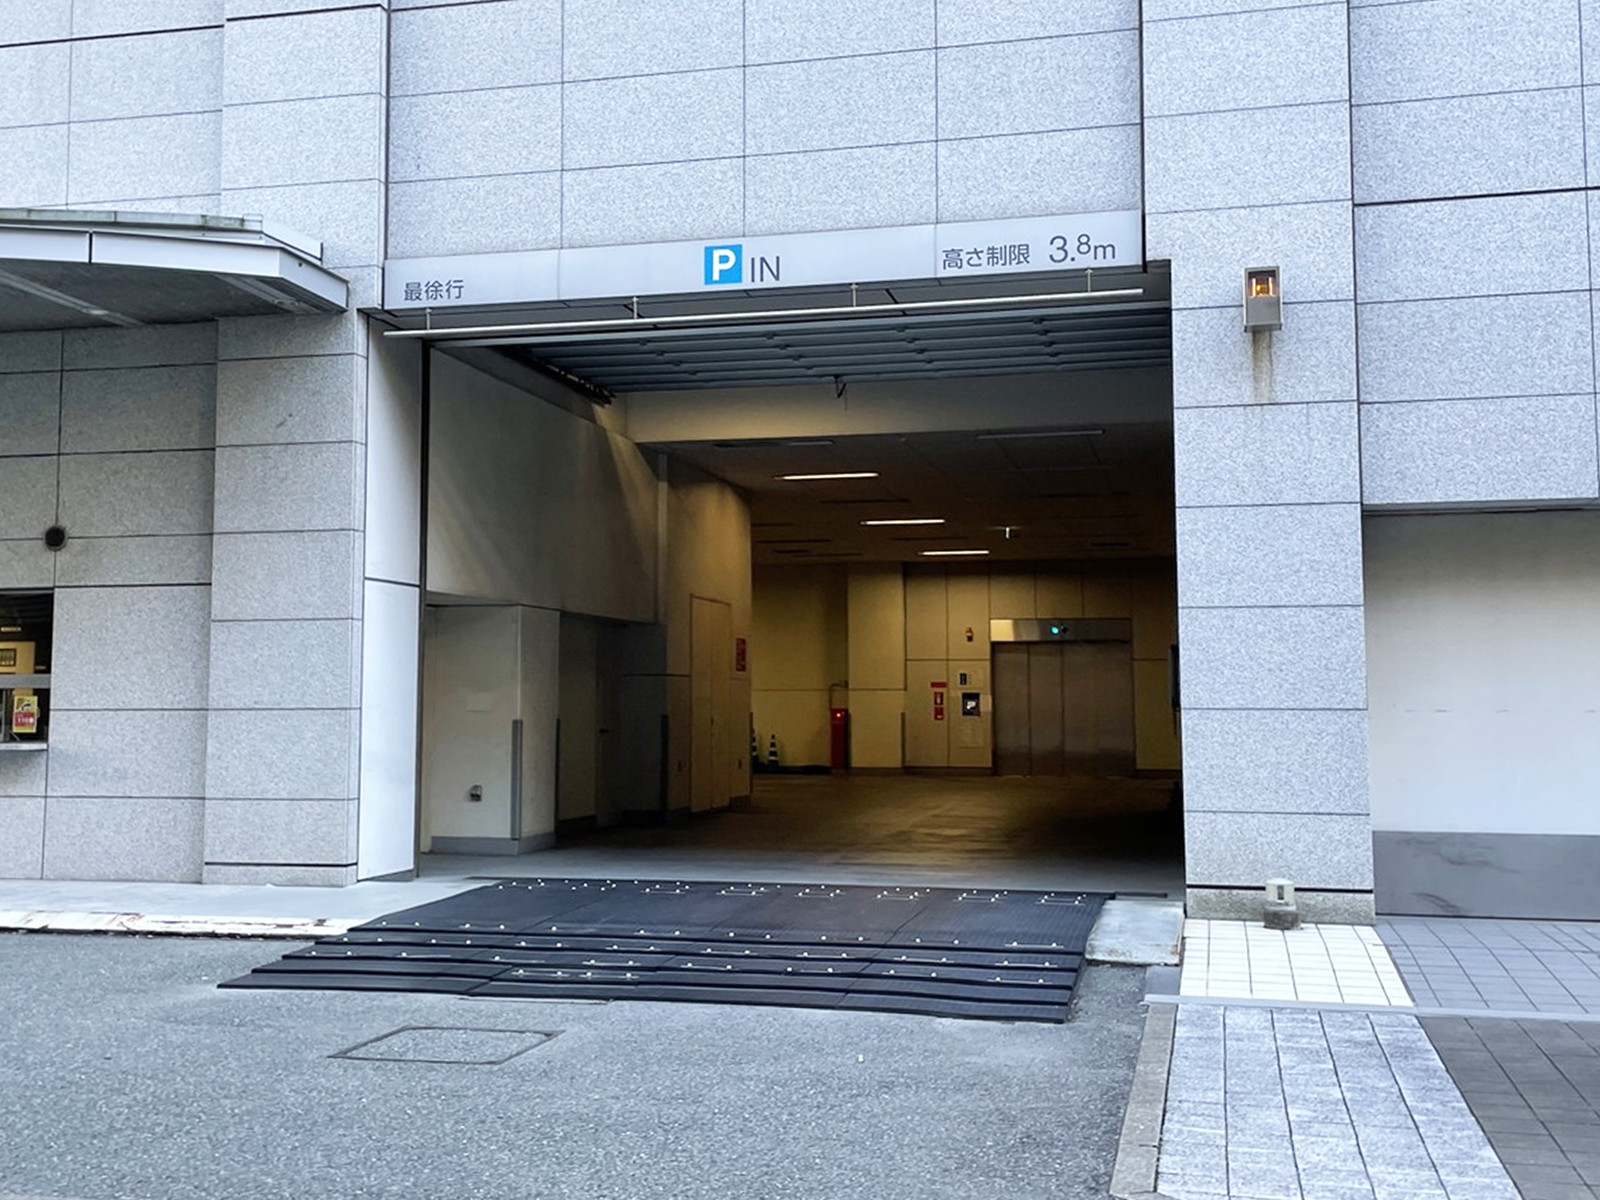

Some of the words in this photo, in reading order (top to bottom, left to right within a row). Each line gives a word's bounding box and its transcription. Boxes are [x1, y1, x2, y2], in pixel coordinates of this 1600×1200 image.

[712, 248, 736, 281] P
[751, 256, 780, 283] IN
[942, 243, 1031, 271] 高さ制限
[1049, 233, 1117, 264] 3.8m
[404, 280, 464, 301] 最徐行
